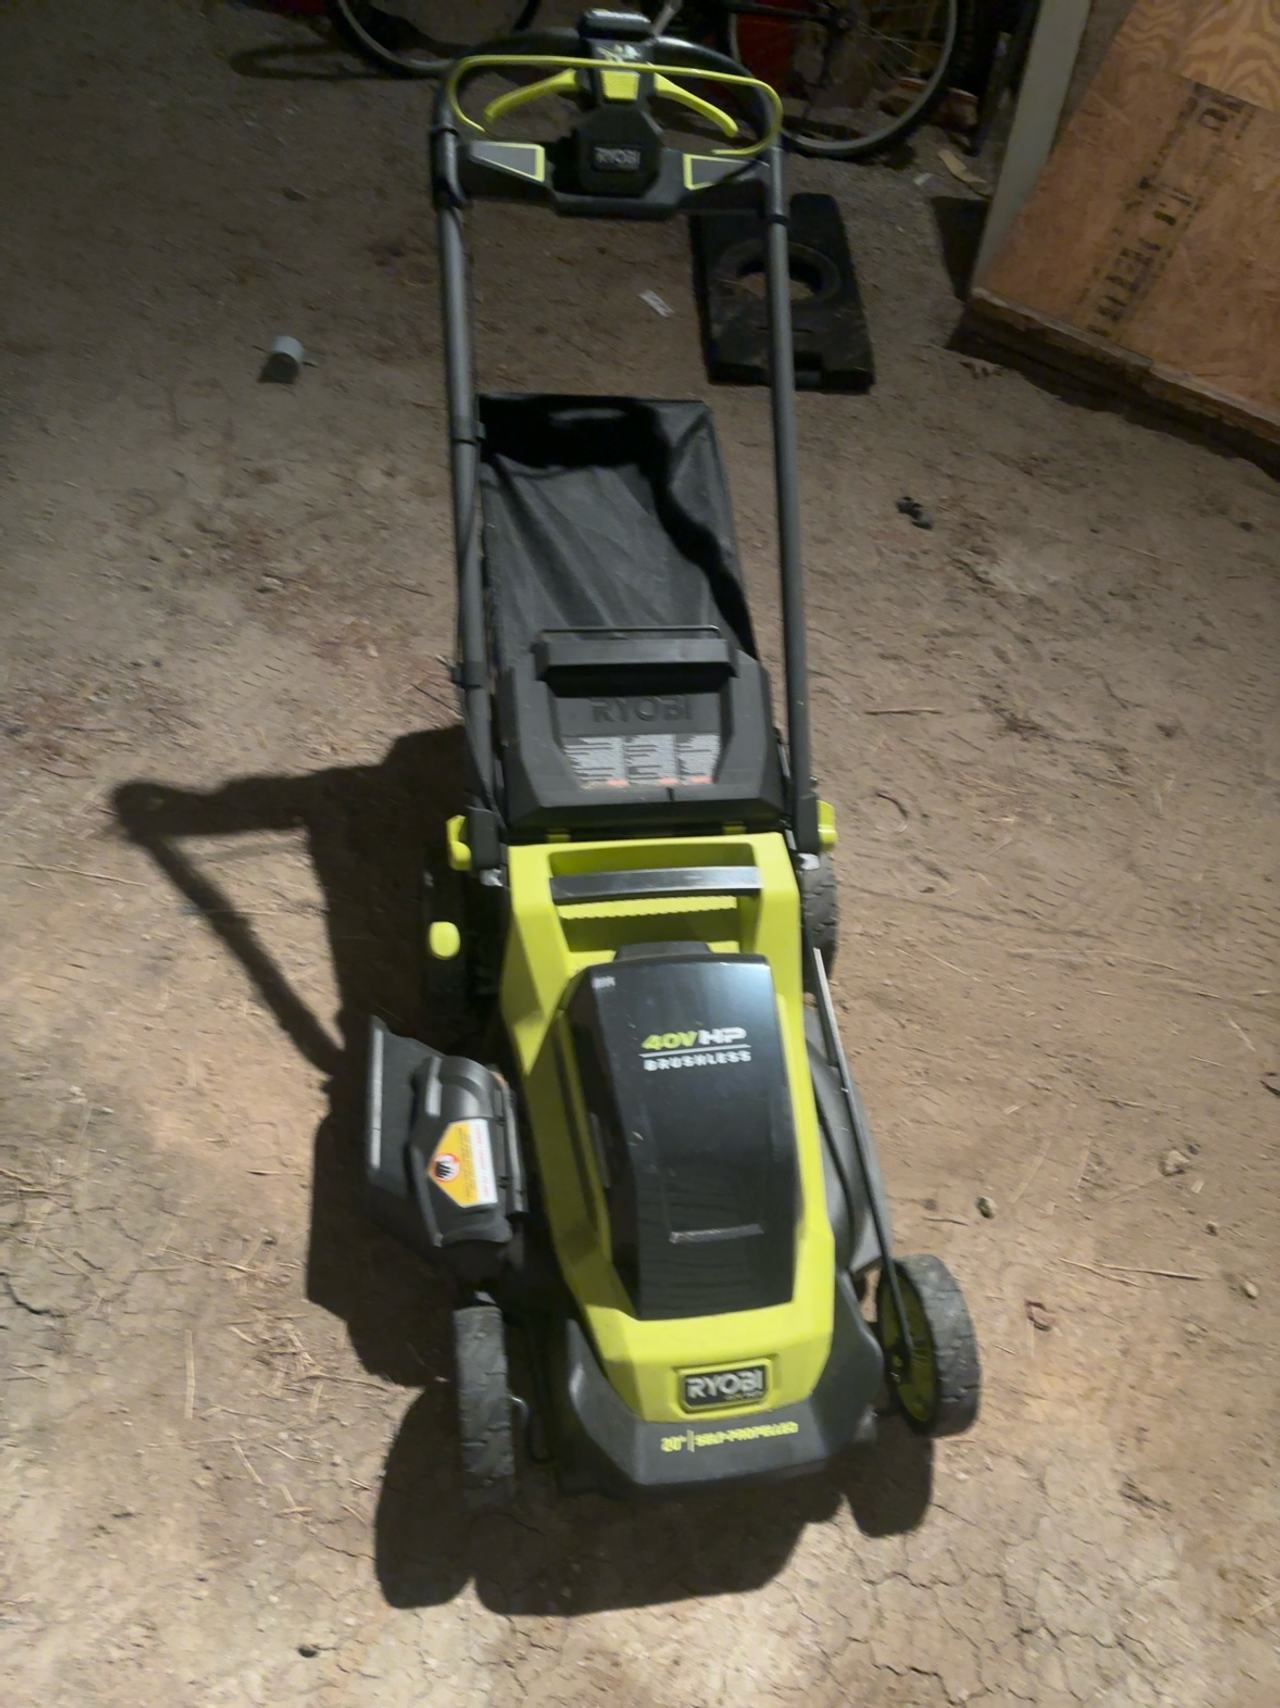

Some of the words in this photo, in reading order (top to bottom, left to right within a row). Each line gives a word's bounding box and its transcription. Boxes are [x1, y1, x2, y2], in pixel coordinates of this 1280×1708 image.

[594, 147, 641, 169] RYOBI
[590, 697, 693, 722] RYOBI
[643, 1050, 752, 1072] BRUSHLESS
[687, 1369, 764, 1399] RYOBI
